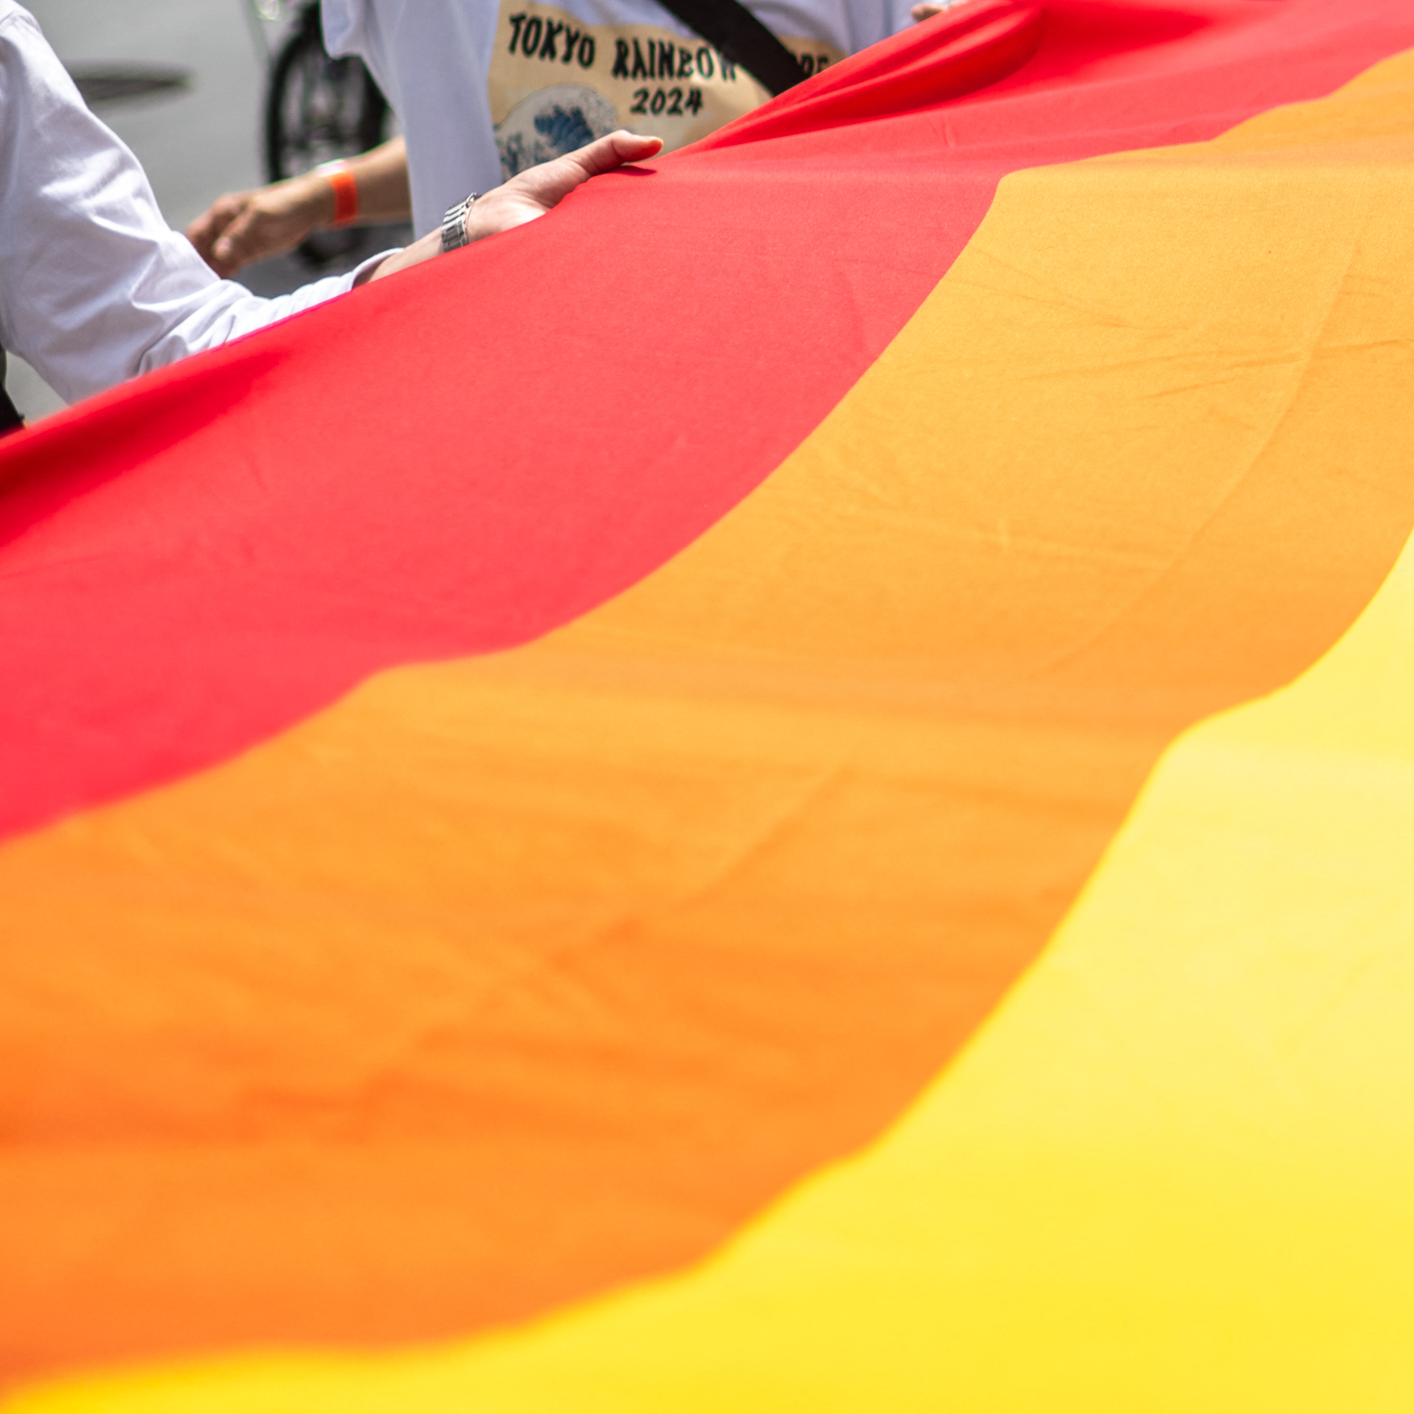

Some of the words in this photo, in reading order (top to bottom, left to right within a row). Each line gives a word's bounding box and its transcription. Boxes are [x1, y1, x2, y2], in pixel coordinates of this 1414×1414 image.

[508, 12, 596, 69] TOKYO
[611, 37, 737, 82] RAINBOW
[629, 87, 703, 116] 2024
